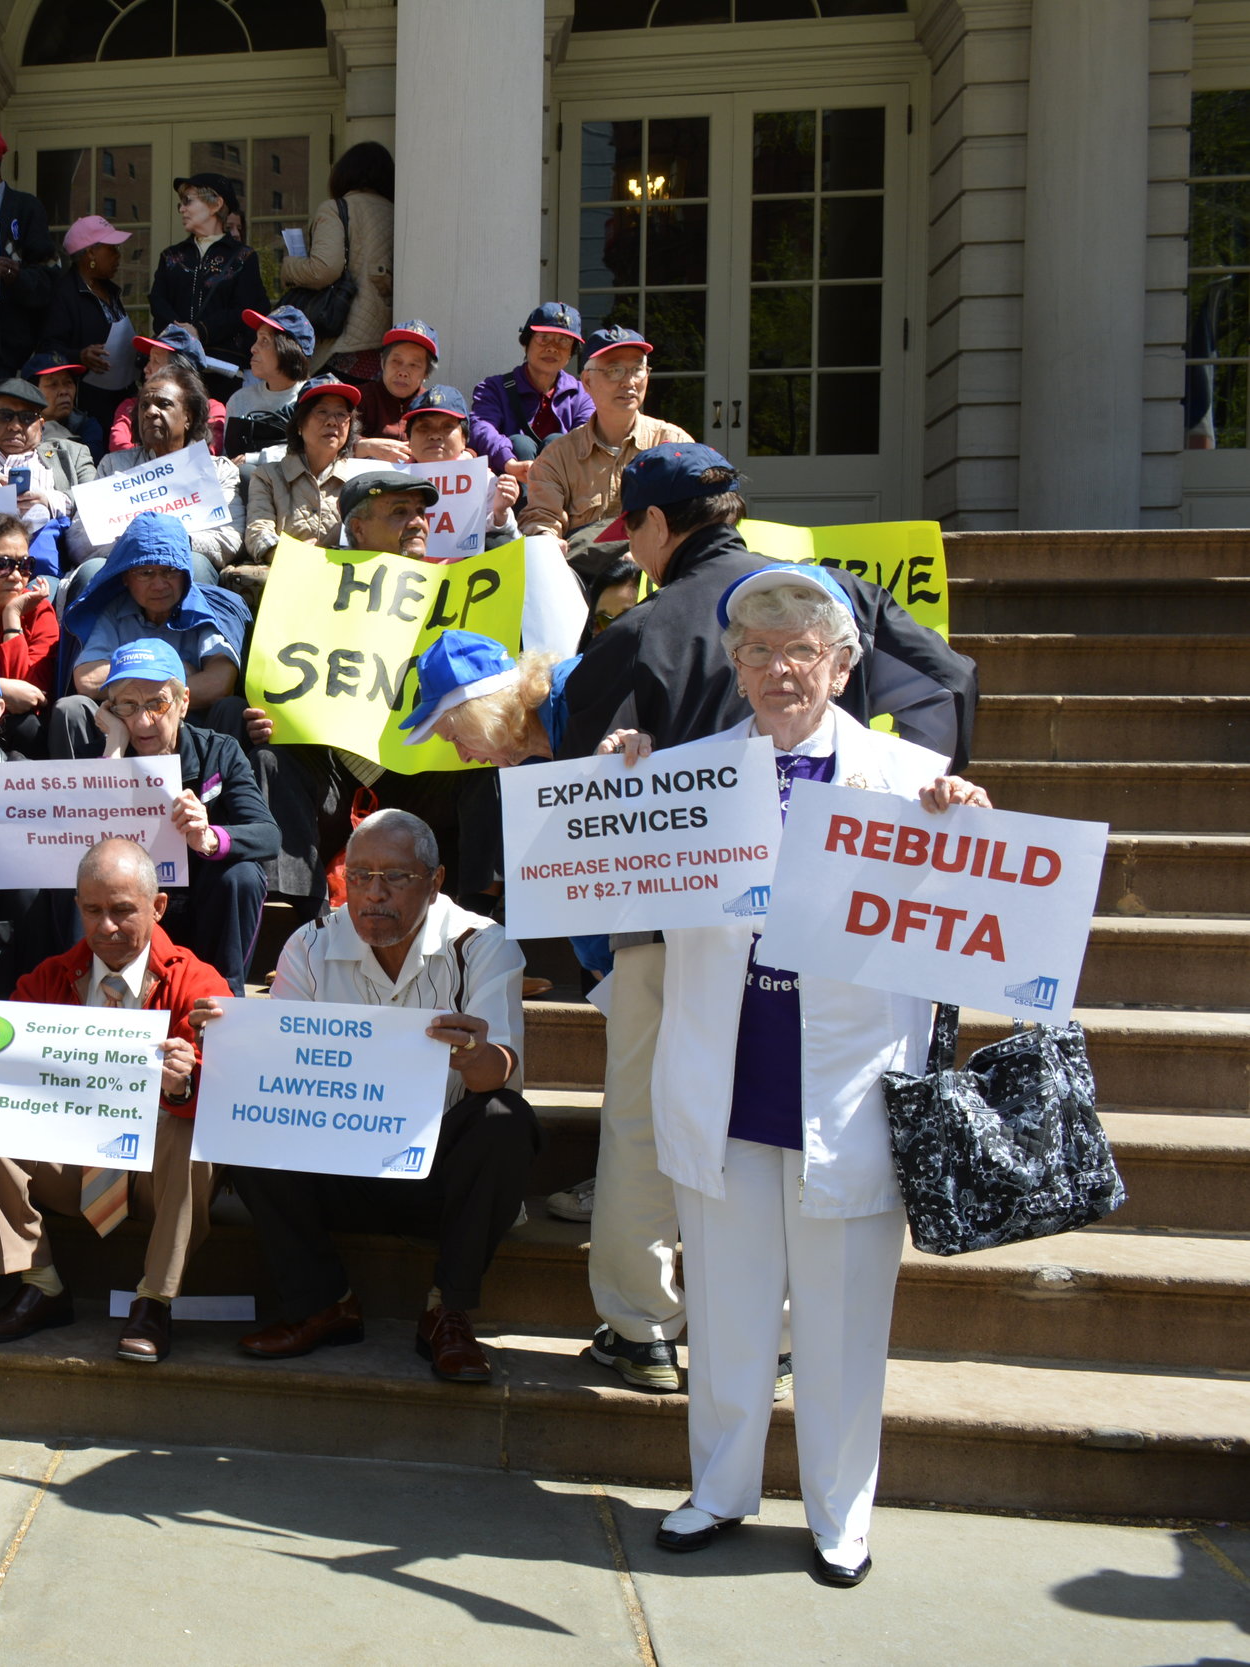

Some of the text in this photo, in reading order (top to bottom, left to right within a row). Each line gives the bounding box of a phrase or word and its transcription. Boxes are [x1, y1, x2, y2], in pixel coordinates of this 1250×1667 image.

[113, 464, 174, 492] SENIORS
[130, 486, 168, 504] NEED
[333, 563, 500, 629] HELP
[4, 776, 164, 792] Add $6.5 Million to
[538, 766, 738, 808] EXPAND NORC
[6, 804, 166, 821] Case Management
[567, 806, 707, 840] SERVICES
[27, 832, 94, 847] Funding
[824, 814, 1062, 887] REBUILD
[522, 845, 768, 880] INCREASE NORC FUNDING
[567, 874, 718, 900] BY $2.7 MILLION
[845, 890, 1005, 963] DFTA
[759, 975, 800, 991] Gree
[26, 1022, 151, 1039] Senior Centers
[280, 1016, 373, 1038] SENIORS
[42, 1046, 148, 1065] Paying More
[296, 1048, 353, 1068] NEED
[39, 1073, 147, 1092] Than 20% of
[259, 1075, 384, 1102] LAWYERS IN
[65, 1102, 92, 1116] For
[98, 1105, 142, 1120] Rent.
[232, 1103, 406, 1135] HOUSING COURT
